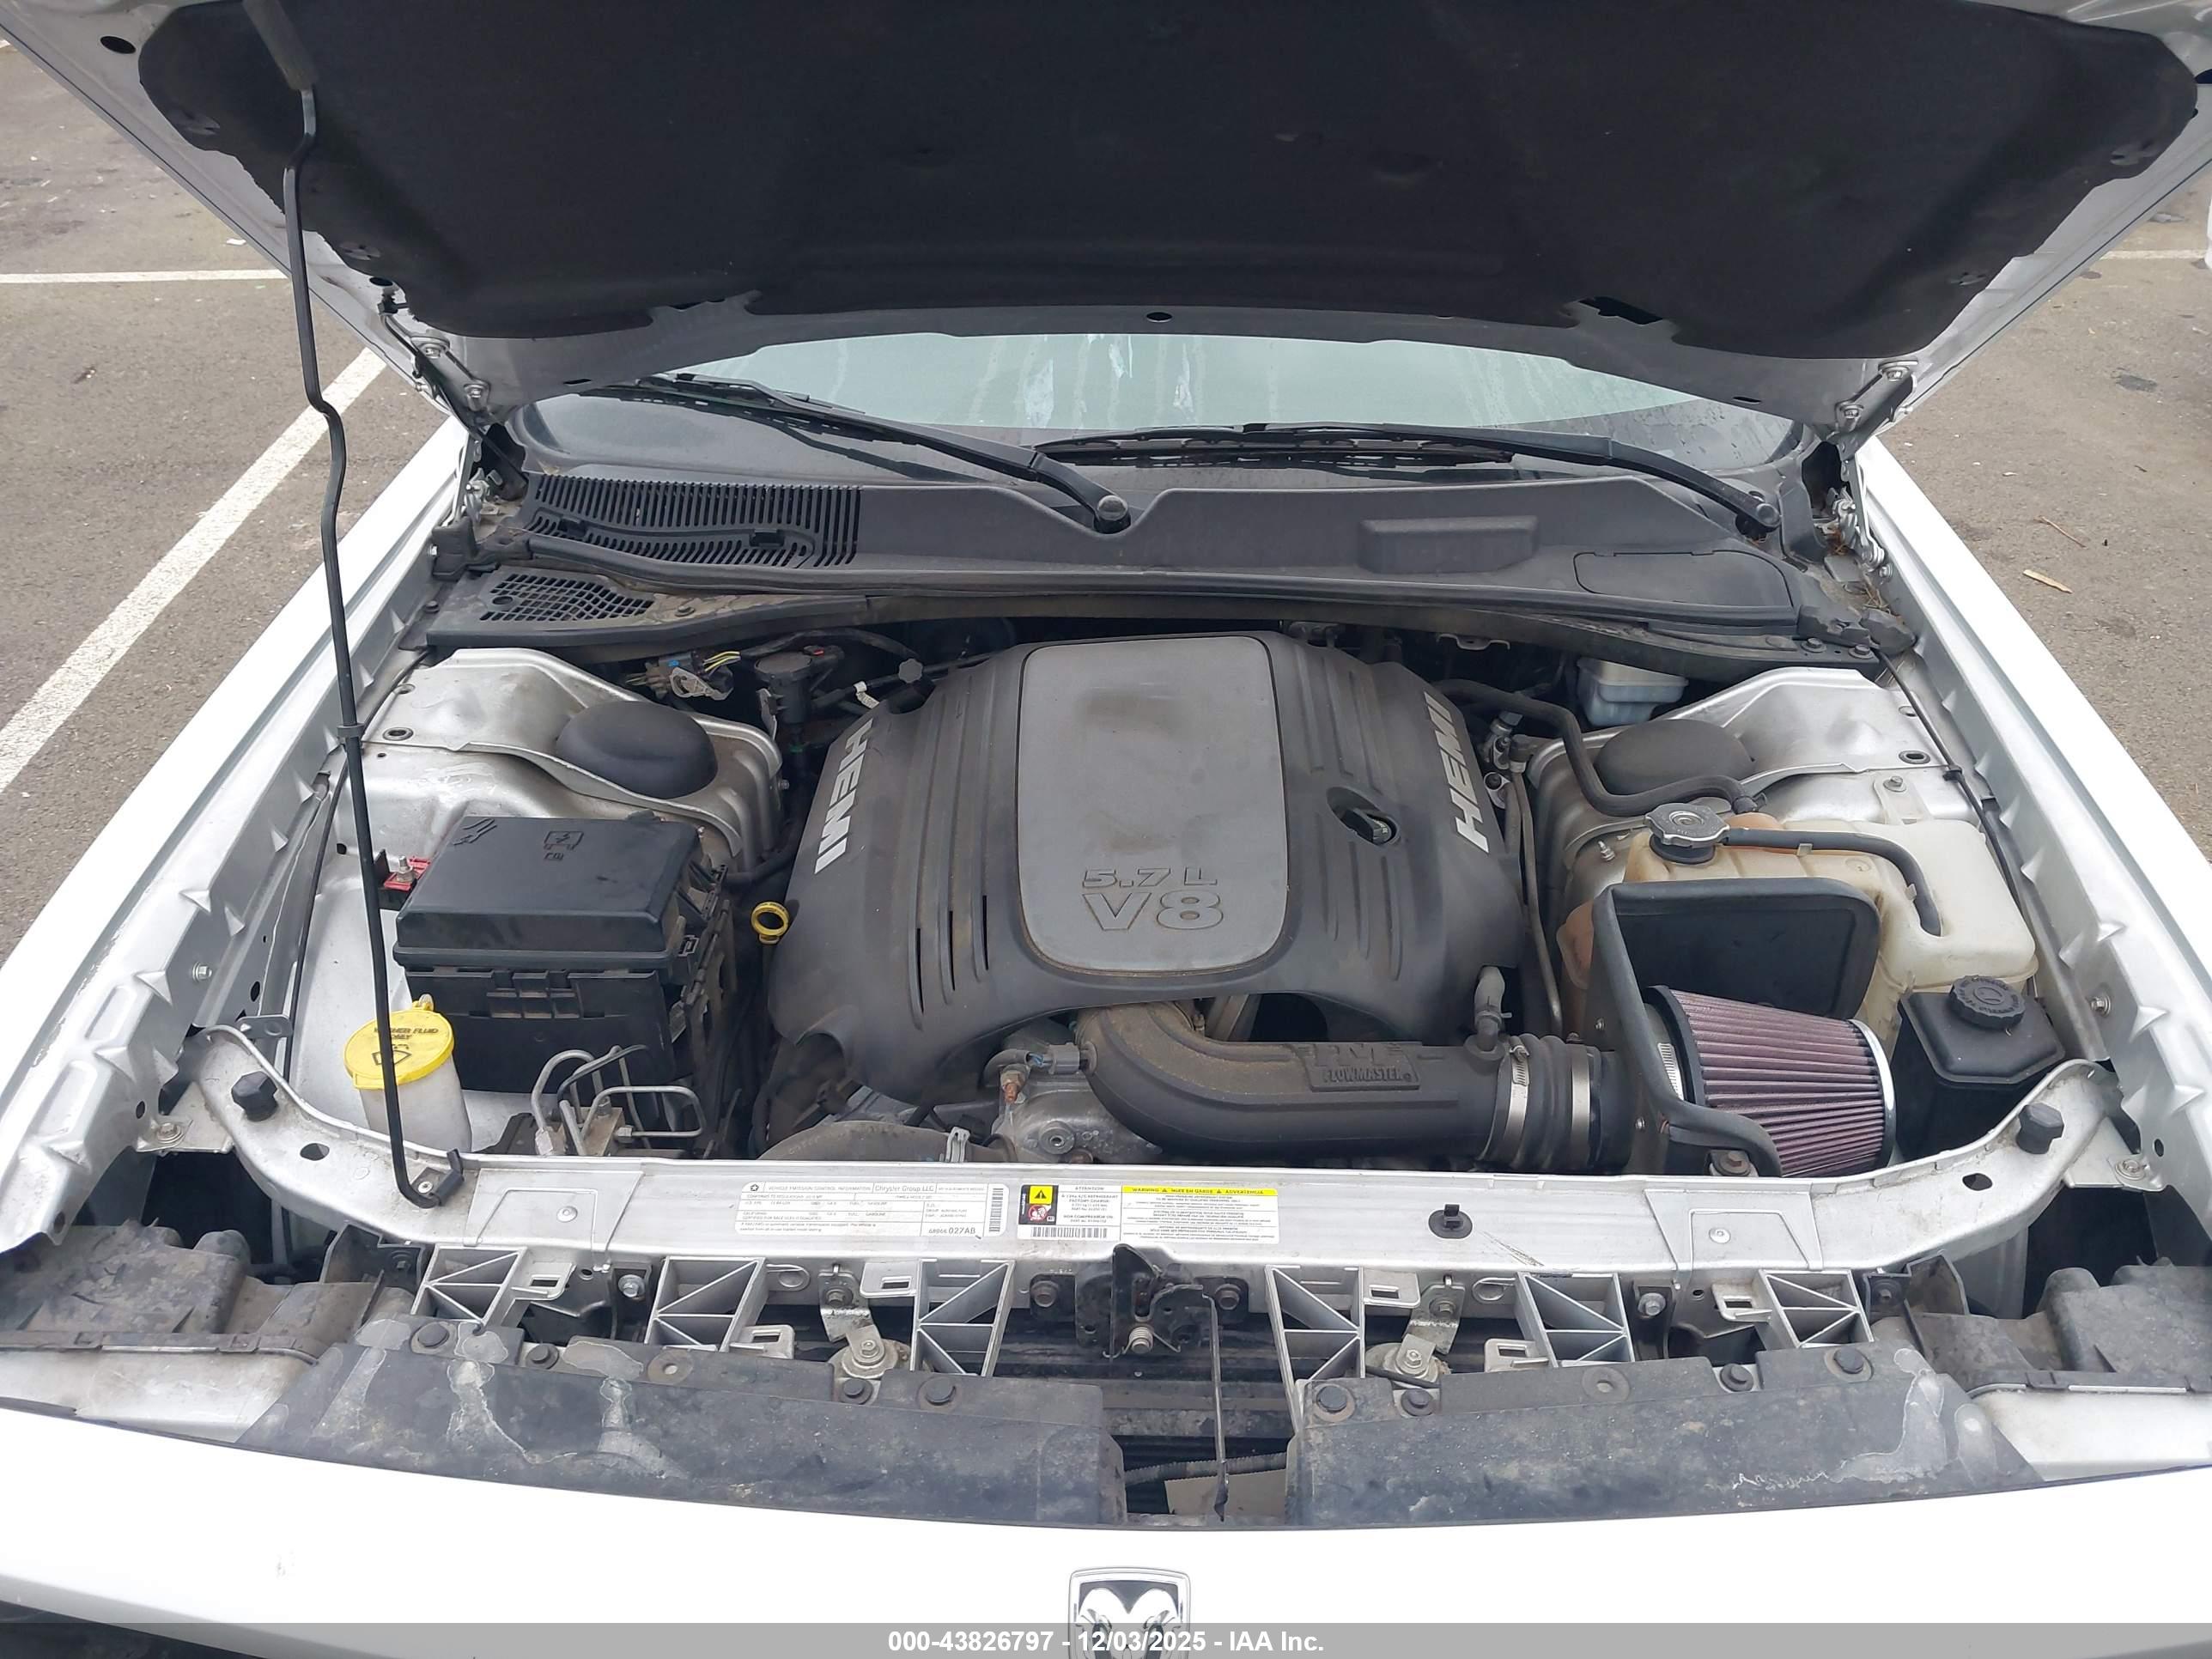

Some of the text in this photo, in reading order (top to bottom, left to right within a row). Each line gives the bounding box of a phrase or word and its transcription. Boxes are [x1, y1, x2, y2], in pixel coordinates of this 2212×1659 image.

[814, 718, 873, 874] HEMI
[1424, 691, 1489, 853] HEMI
[1082, 890, 1224, 931] V8
[875, 1185, 901, 1194] Chrysler
[902, 1185, 921, 1194] Group
